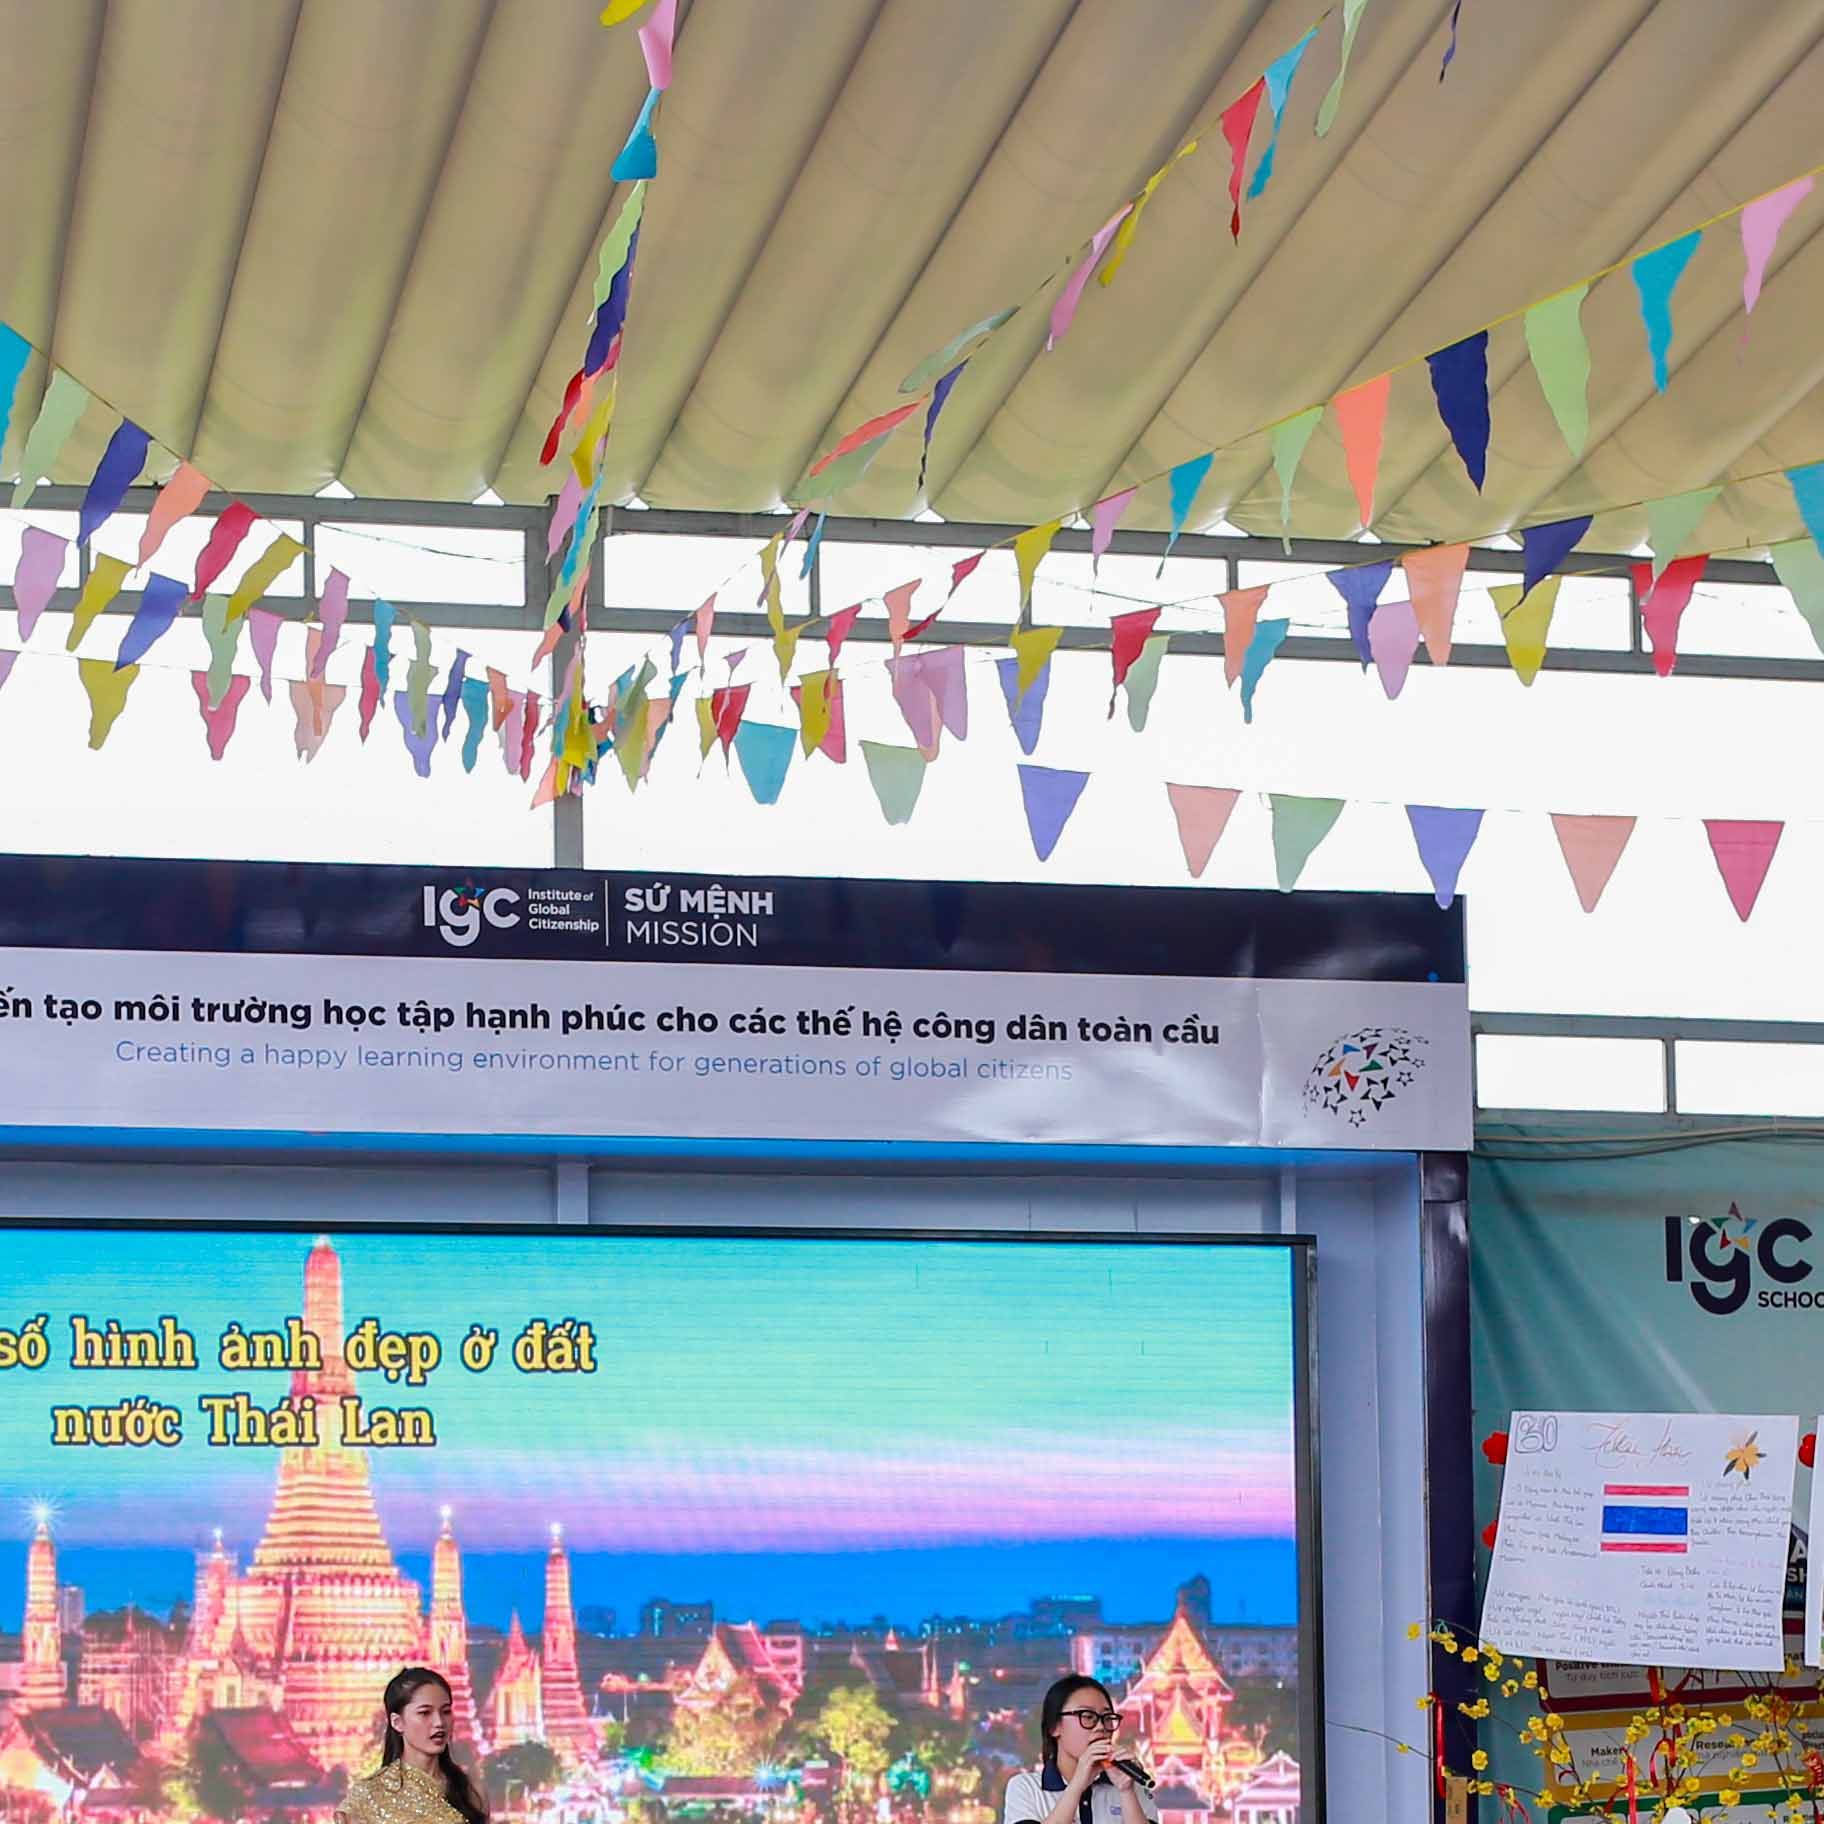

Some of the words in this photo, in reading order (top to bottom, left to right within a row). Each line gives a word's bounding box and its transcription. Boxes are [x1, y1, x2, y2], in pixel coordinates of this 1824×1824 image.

[528, 888, 581, 901] Institute
[583, 890, 594, 902] of
[529, 903, 571, 916] Global
[624, 882, 671, 913] SỨ
[680, 883, 774, 920] MỆNH
[529, 917, 599, 933] Citizenship
[627, 921, 758, 947] MISSION
[44, 994, 103, 1026] tạo
[114, 993, 180, 1022] môi
[192, 994, 312, 1029] trường
[324, 997, 386, 1034] học
[397, 998, 456, 1034] tập
[466, 1001, 551, 1036] hạnh
[563, 1001, 646, 1038] phúc
[656, 1005, 719, 1035] cho
[729, 1007, 787, 1036] các
[796, 1005, 856, 1037] thế
[862, 1009, 903, 1047] hệ
[912, 1010, 996, 1045] công
[1006, 1011, 1068, 1043] dân
[1078, 1014, 1153, 1045] toàn
[1163, 1011, 1221, 1047] cầu
[115, 1040, 231, 1068] Creating
[239, 1047, 255, 1067] a
[265, 1043, 348, 1072] happy
[358, 1045, 464, 1072] learning
[473, 1048, 640, 1073] environment
[649, 1051, 686, 1073] for
[694, 1053, 847, 1080] generations
[855, 1053, 883, 1078] of
[890, 1055, 969, 1082] global
[977, 1056, 1074, 1082] citizens
[70, 1317, 198, 1371] hình
[219, 1319, 323, 1371] ảnh
[345, 1319, 440, 1384] đẹp
[461, 1323, 496, 1372] ở
[513, 1318, 598, 1374] đất
[52, 1397, 182, 1447] nước
[203, 1394, 322, 1448] Thái
[341, 1399, 438, 1448] Lan
